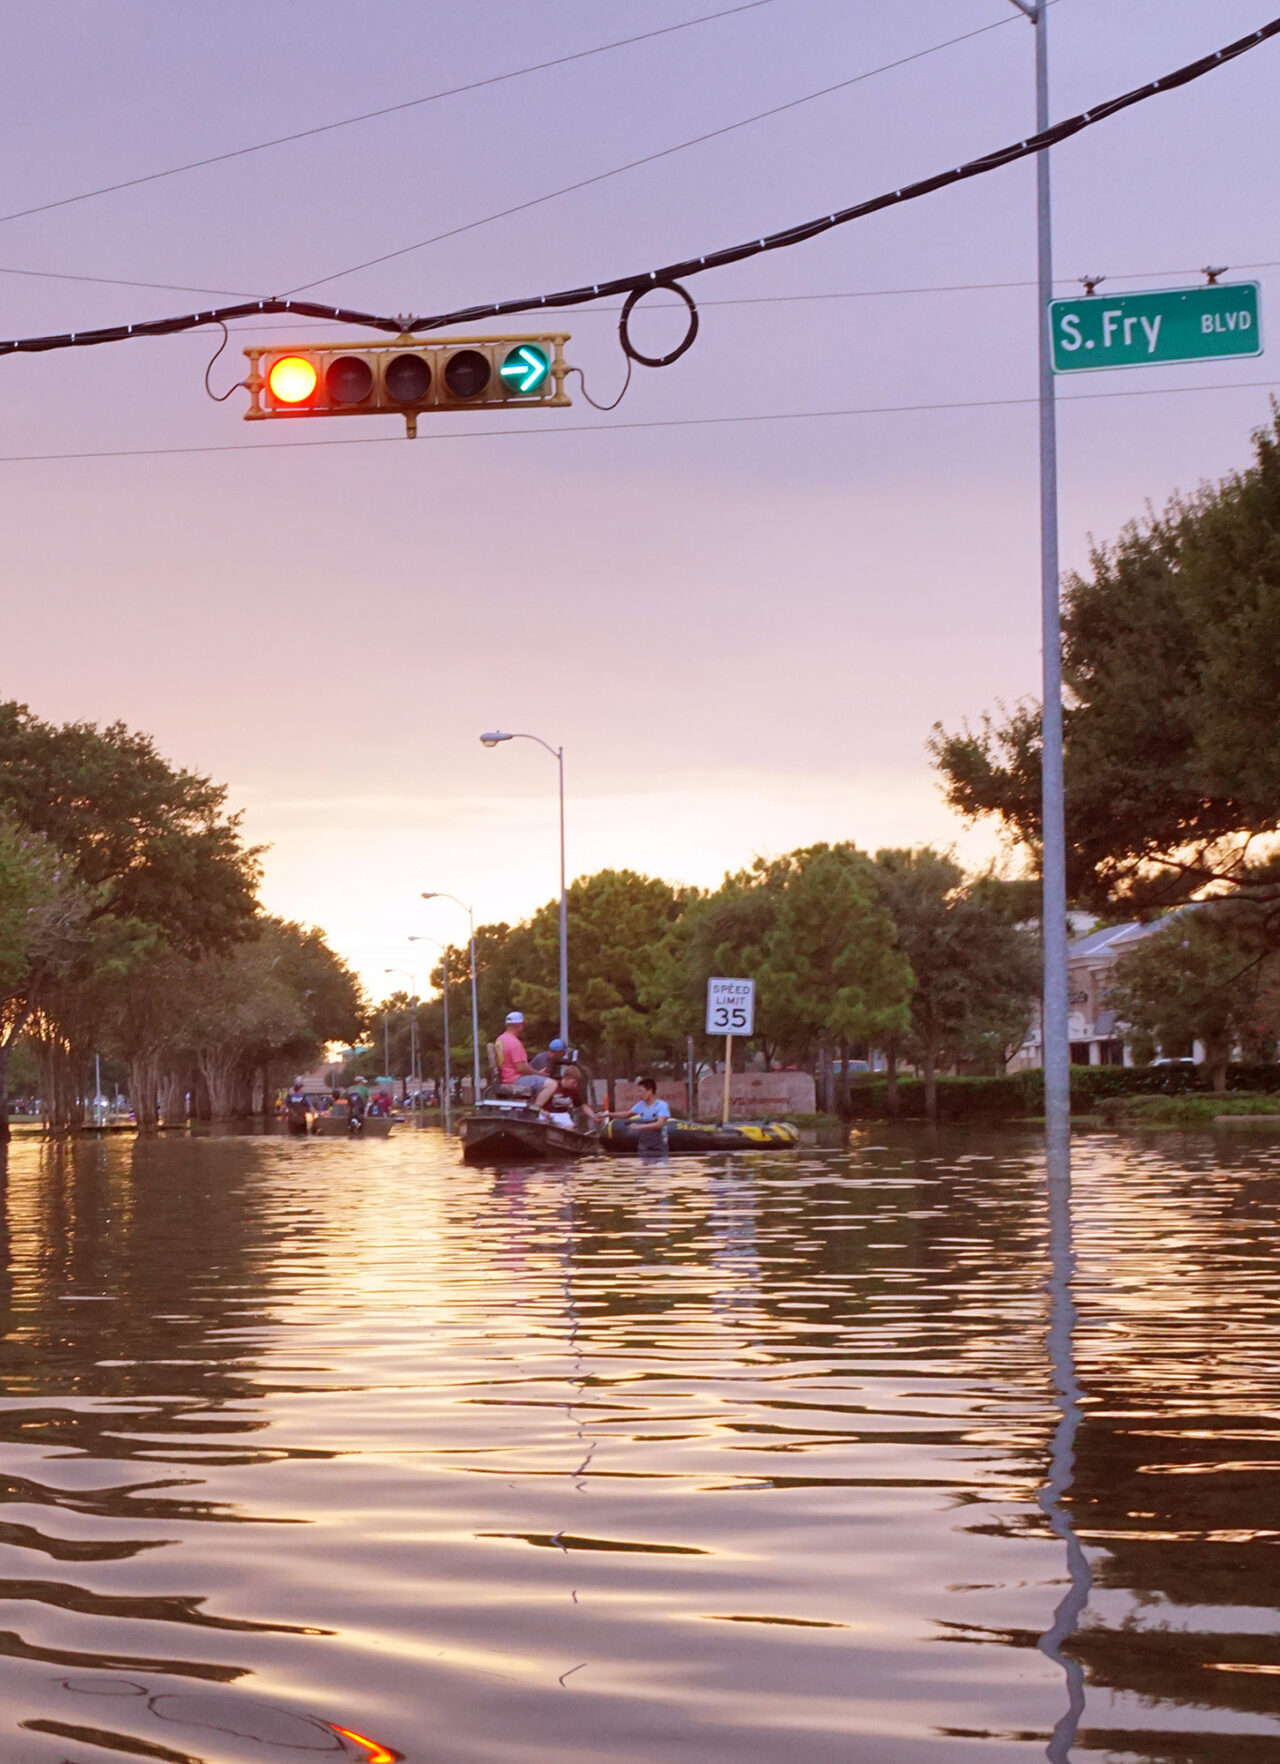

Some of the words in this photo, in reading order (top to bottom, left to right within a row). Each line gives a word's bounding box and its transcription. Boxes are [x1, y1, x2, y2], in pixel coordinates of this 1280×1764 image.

[1060, 313, 1095, 351] S.
[1102, 310, 1162, 353] Fry
[1201, 311, 1252, 334] BLVD
[713, 984, 751, 995] SPEED
[716, 997, 746, 1006] LIMIT
[714, 1007, 747, 1028] 35
